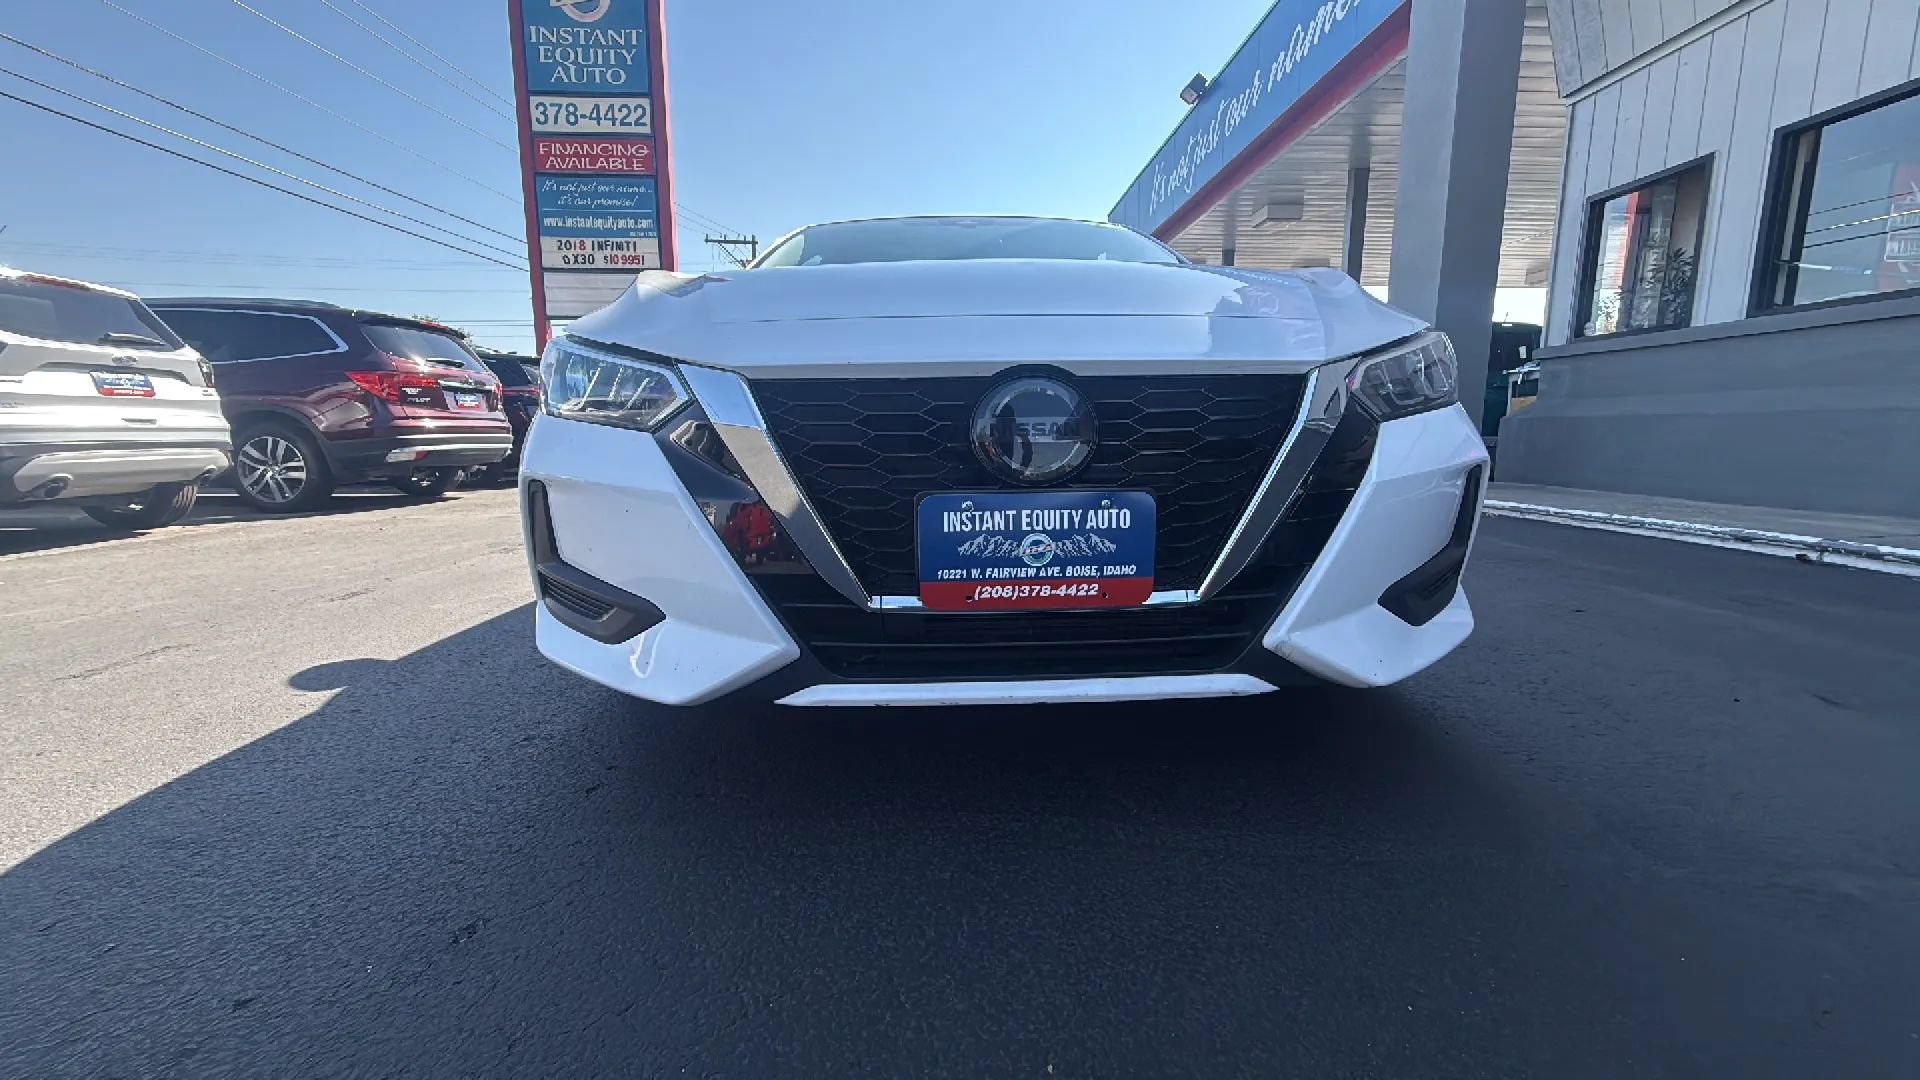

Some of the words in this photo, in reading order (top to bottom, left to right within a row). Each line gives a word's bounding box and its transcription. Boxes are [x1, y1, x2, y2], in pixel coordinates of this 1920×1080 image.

[529, 25, 643, 46] INSTANT
[538, 45, 637, 67] EQUITY
[550, 65, 627, 85] AUTO
[534, 102, 648, 127] 378-4422
[1168, 135, 1196, 197] not
[1184, 98, 1230, 193] just
[1225, 70, 1264, 136] our
[539, 142, 649, 157] FINANCING
[545, 156, 645, 171] AVAILABLE
[543, 215, 654, 231] www.instantequityauto.com
[557, 239, 587, 251] 2018
[943, 509, 1017, 532] INSTANT
[1021, 508, 1083, 531] EQUITY
[1086, 508, 1131, 529] AUTO
[937, 568, 967, 580] 10221
[971, 568, 983, 579] W.
[985, 567, 1036, 579] FAIRVIEW
[1039, 566, 1063, 577] AVE.
[1065, 565, 1100, 578] BOISE,
[1103, 564, 1137, 576] IDAHO
[974, 583, 1099, 600] (208)378-4422
